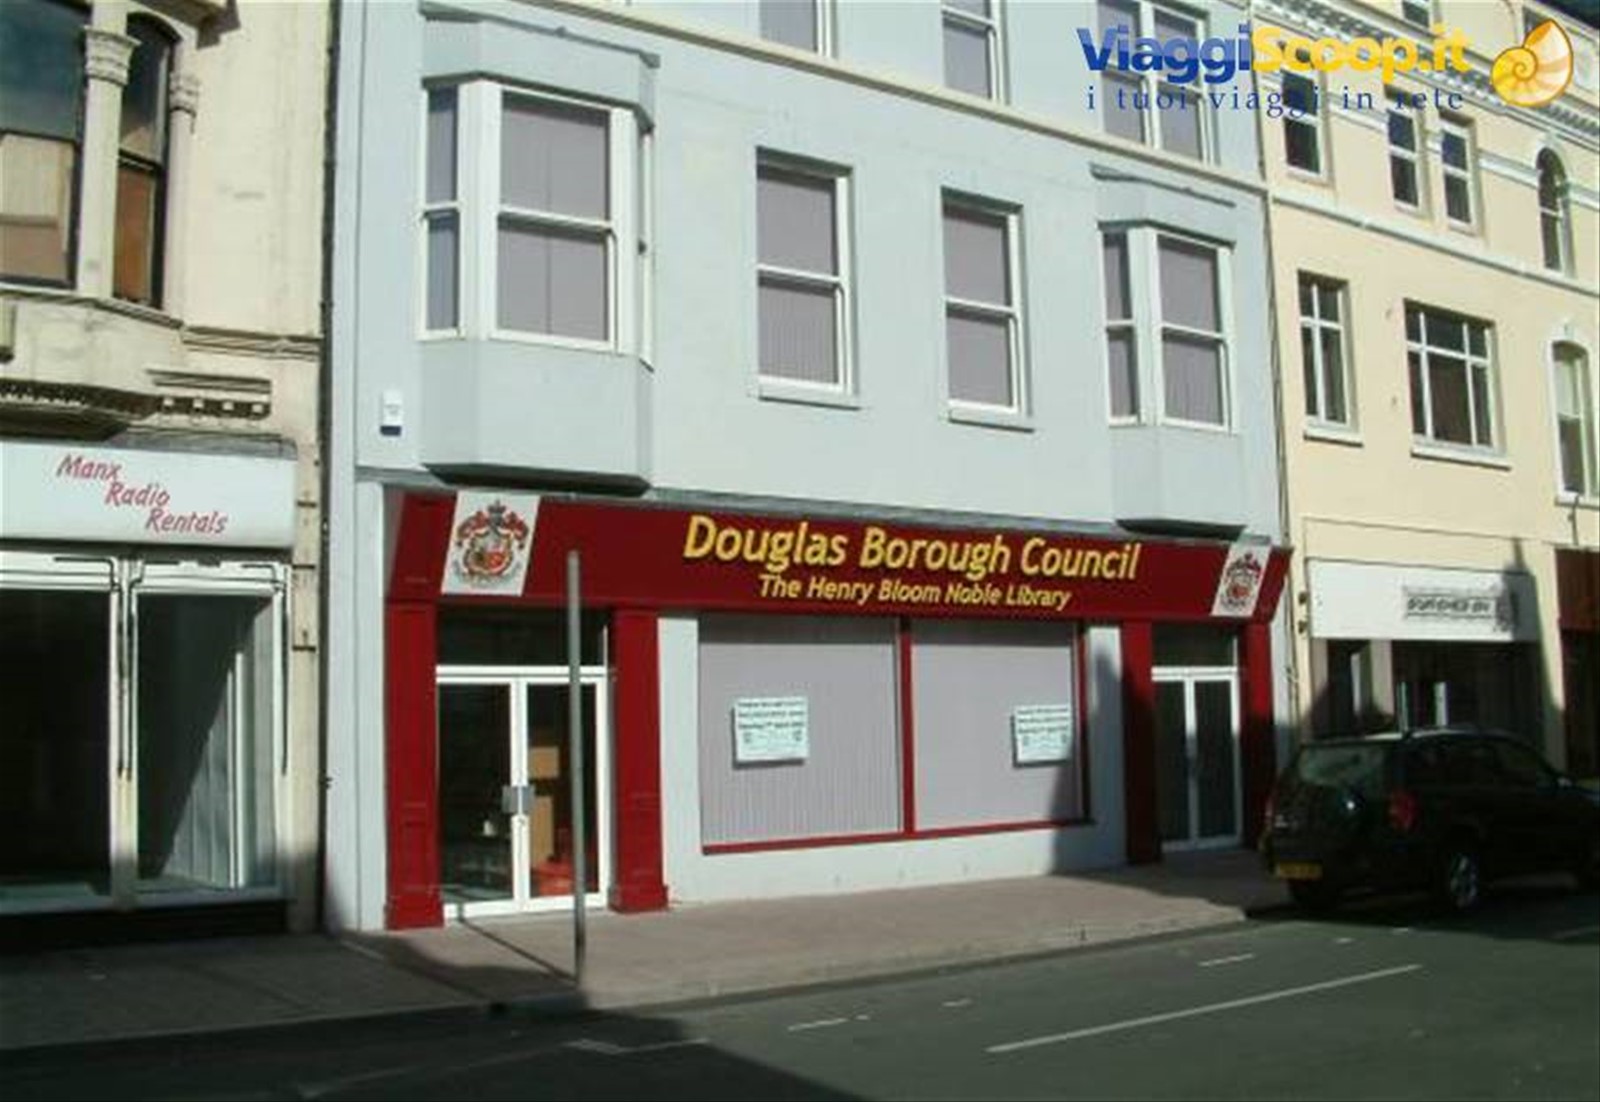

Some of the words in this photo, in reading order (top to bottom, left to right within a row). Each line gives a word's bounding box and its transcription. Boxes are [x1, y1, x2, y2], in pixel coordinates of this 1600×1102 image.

[57, 454, 122, 480] Manx
[105, 482, 170, 507] Radio
[145, 508, 228, 533] Rentals
[684, 515, 847, 572] Douglas
[860, 527, 1009, 579] Borough
[1021, 537, 1140, 579] Council
[758, 574, 800, 598] The
[807, 577, 872, 605] Henry
[878, 579, 940, 602] Bloom
[945, 583, 1002, 605] Noble
[1006, 587, 1071, 610] Library
